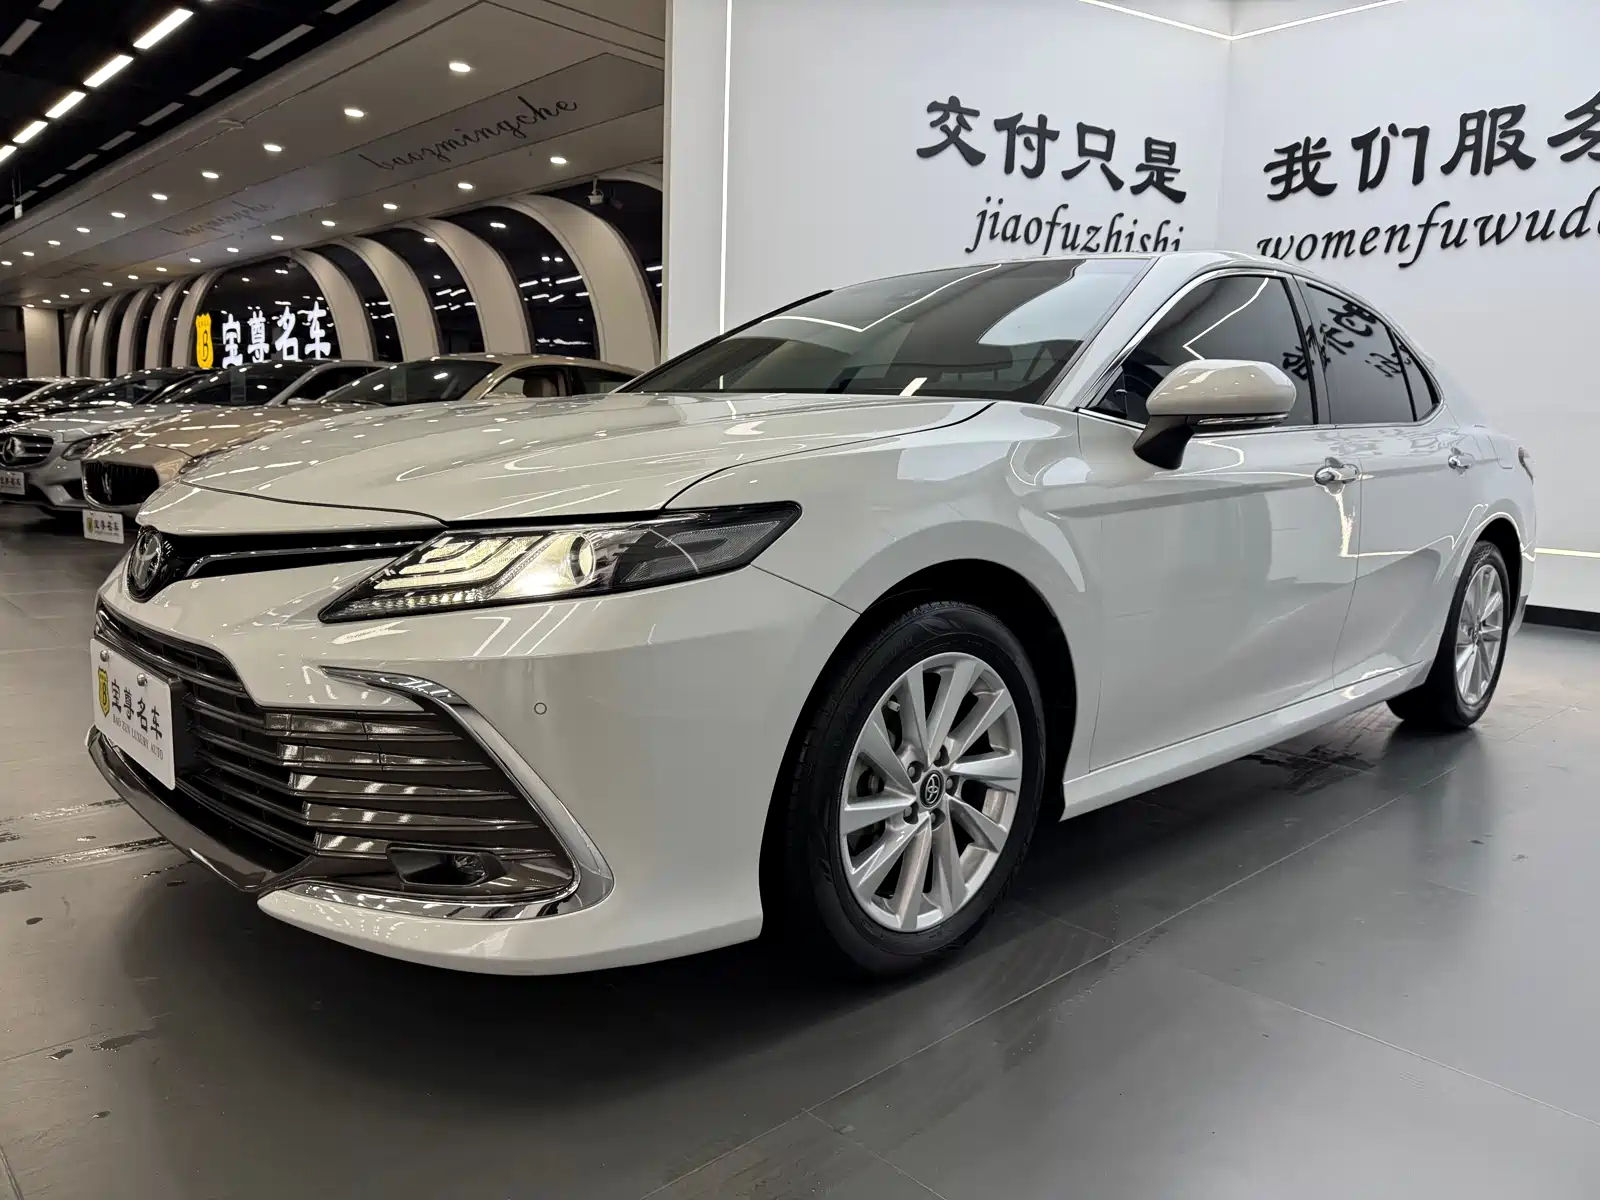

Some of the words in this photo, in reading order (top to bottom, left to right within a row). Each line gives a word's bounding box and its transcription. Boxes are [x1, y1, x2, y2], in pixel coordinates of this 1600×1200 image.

[917, 95, 1187, 204] 交付只是
[222, 300, 332, 369] 宝尊名车
[111, 678, 163, 741] 宝尊名车
